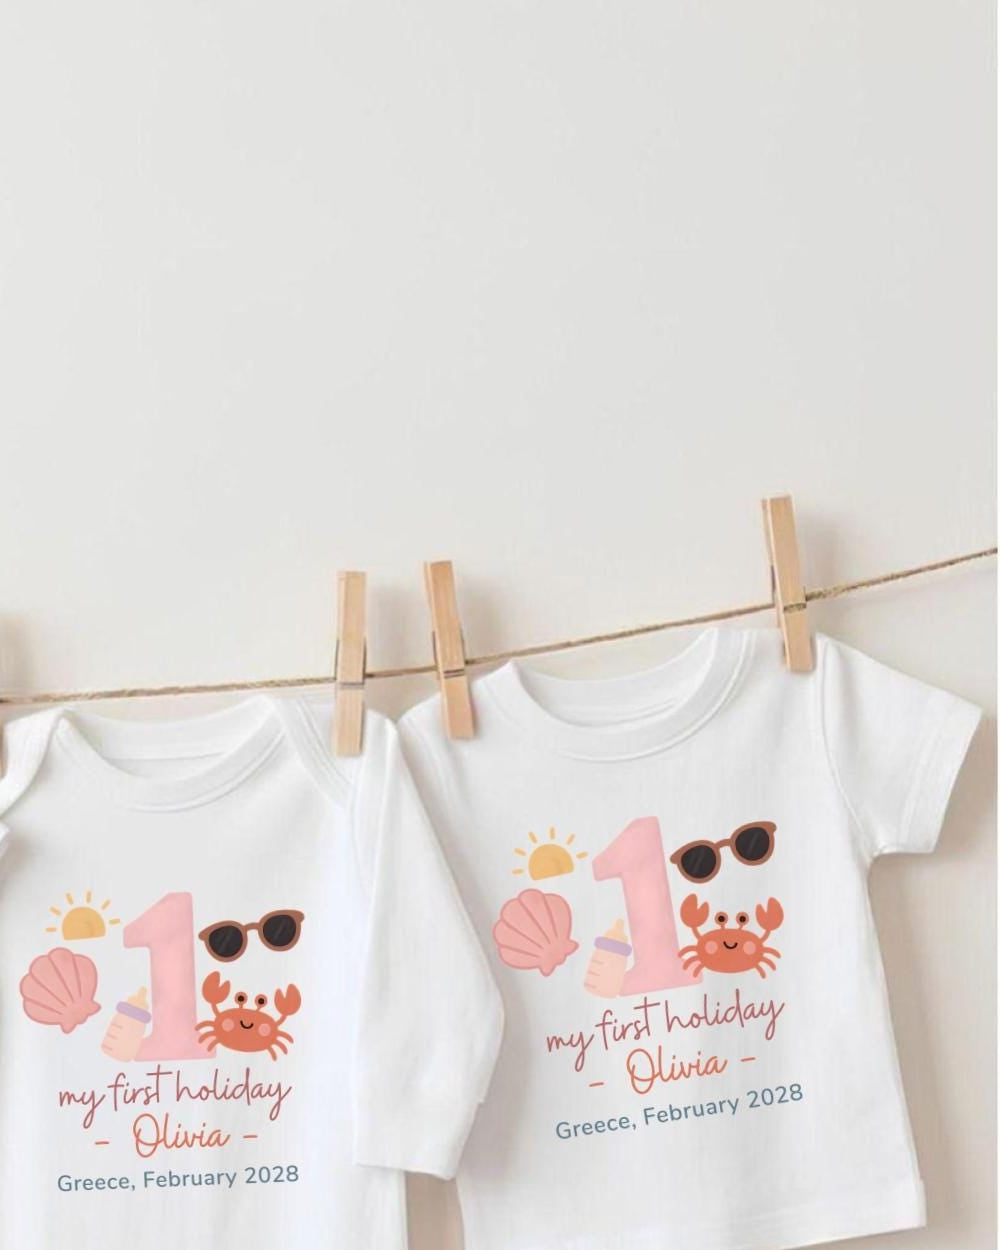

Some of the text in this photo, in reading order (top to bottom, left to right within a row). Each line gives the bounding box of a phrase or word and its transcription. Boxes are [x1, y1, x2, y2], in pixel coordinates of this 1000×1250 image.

[592, 815, 703, 997] 1
[123, 891, 217, 1062] 1
[546, 988, 785, 1072] my first holiday
[59, 1064, 293, 1129] my first holiday
[626, 1045, 728, 1095] Olivia
[132, 1112, 231, 1158] Olivia
[555, 1083, 804, 1140] Greece, February 2028
[57, 1165, 299, 1192] Greece, February 2028
